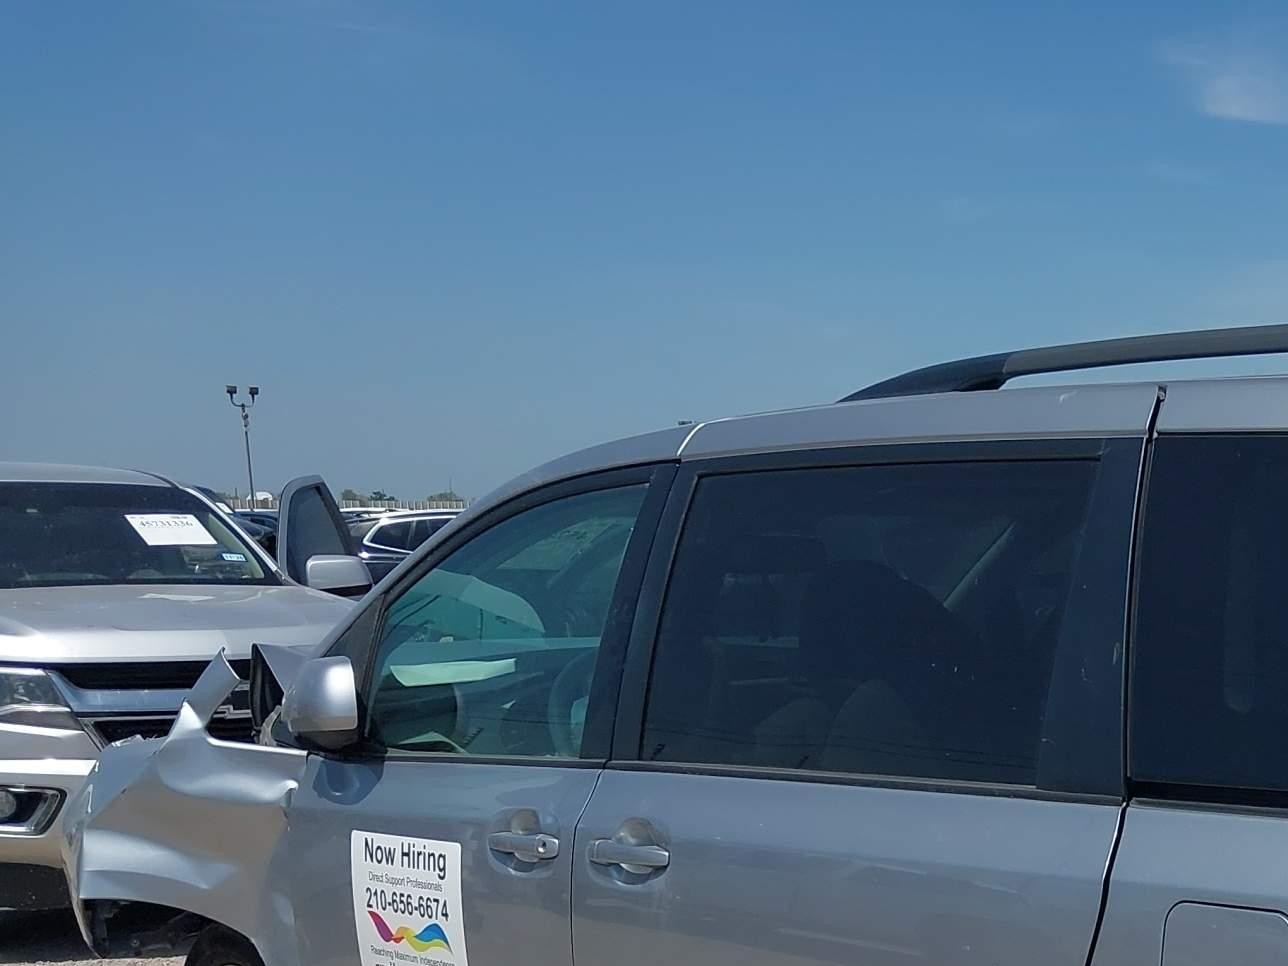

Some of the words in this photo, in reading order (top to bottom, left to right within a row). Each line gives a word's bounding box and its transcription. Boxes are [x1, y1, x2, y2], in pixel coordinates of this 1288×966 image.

[364, 836, 396, 866] Now
[401, 841, 446, 880] Hiring
[368, 871, 384, 883] Direct
[384, 873, 406, 888] Support
[406, 876, 443, 892] Professionals
[366, 887, 449, 921] 210-656-6674
[370, 944, 394, 960] Reaching
[394, 950, 419, 964] Maximum
